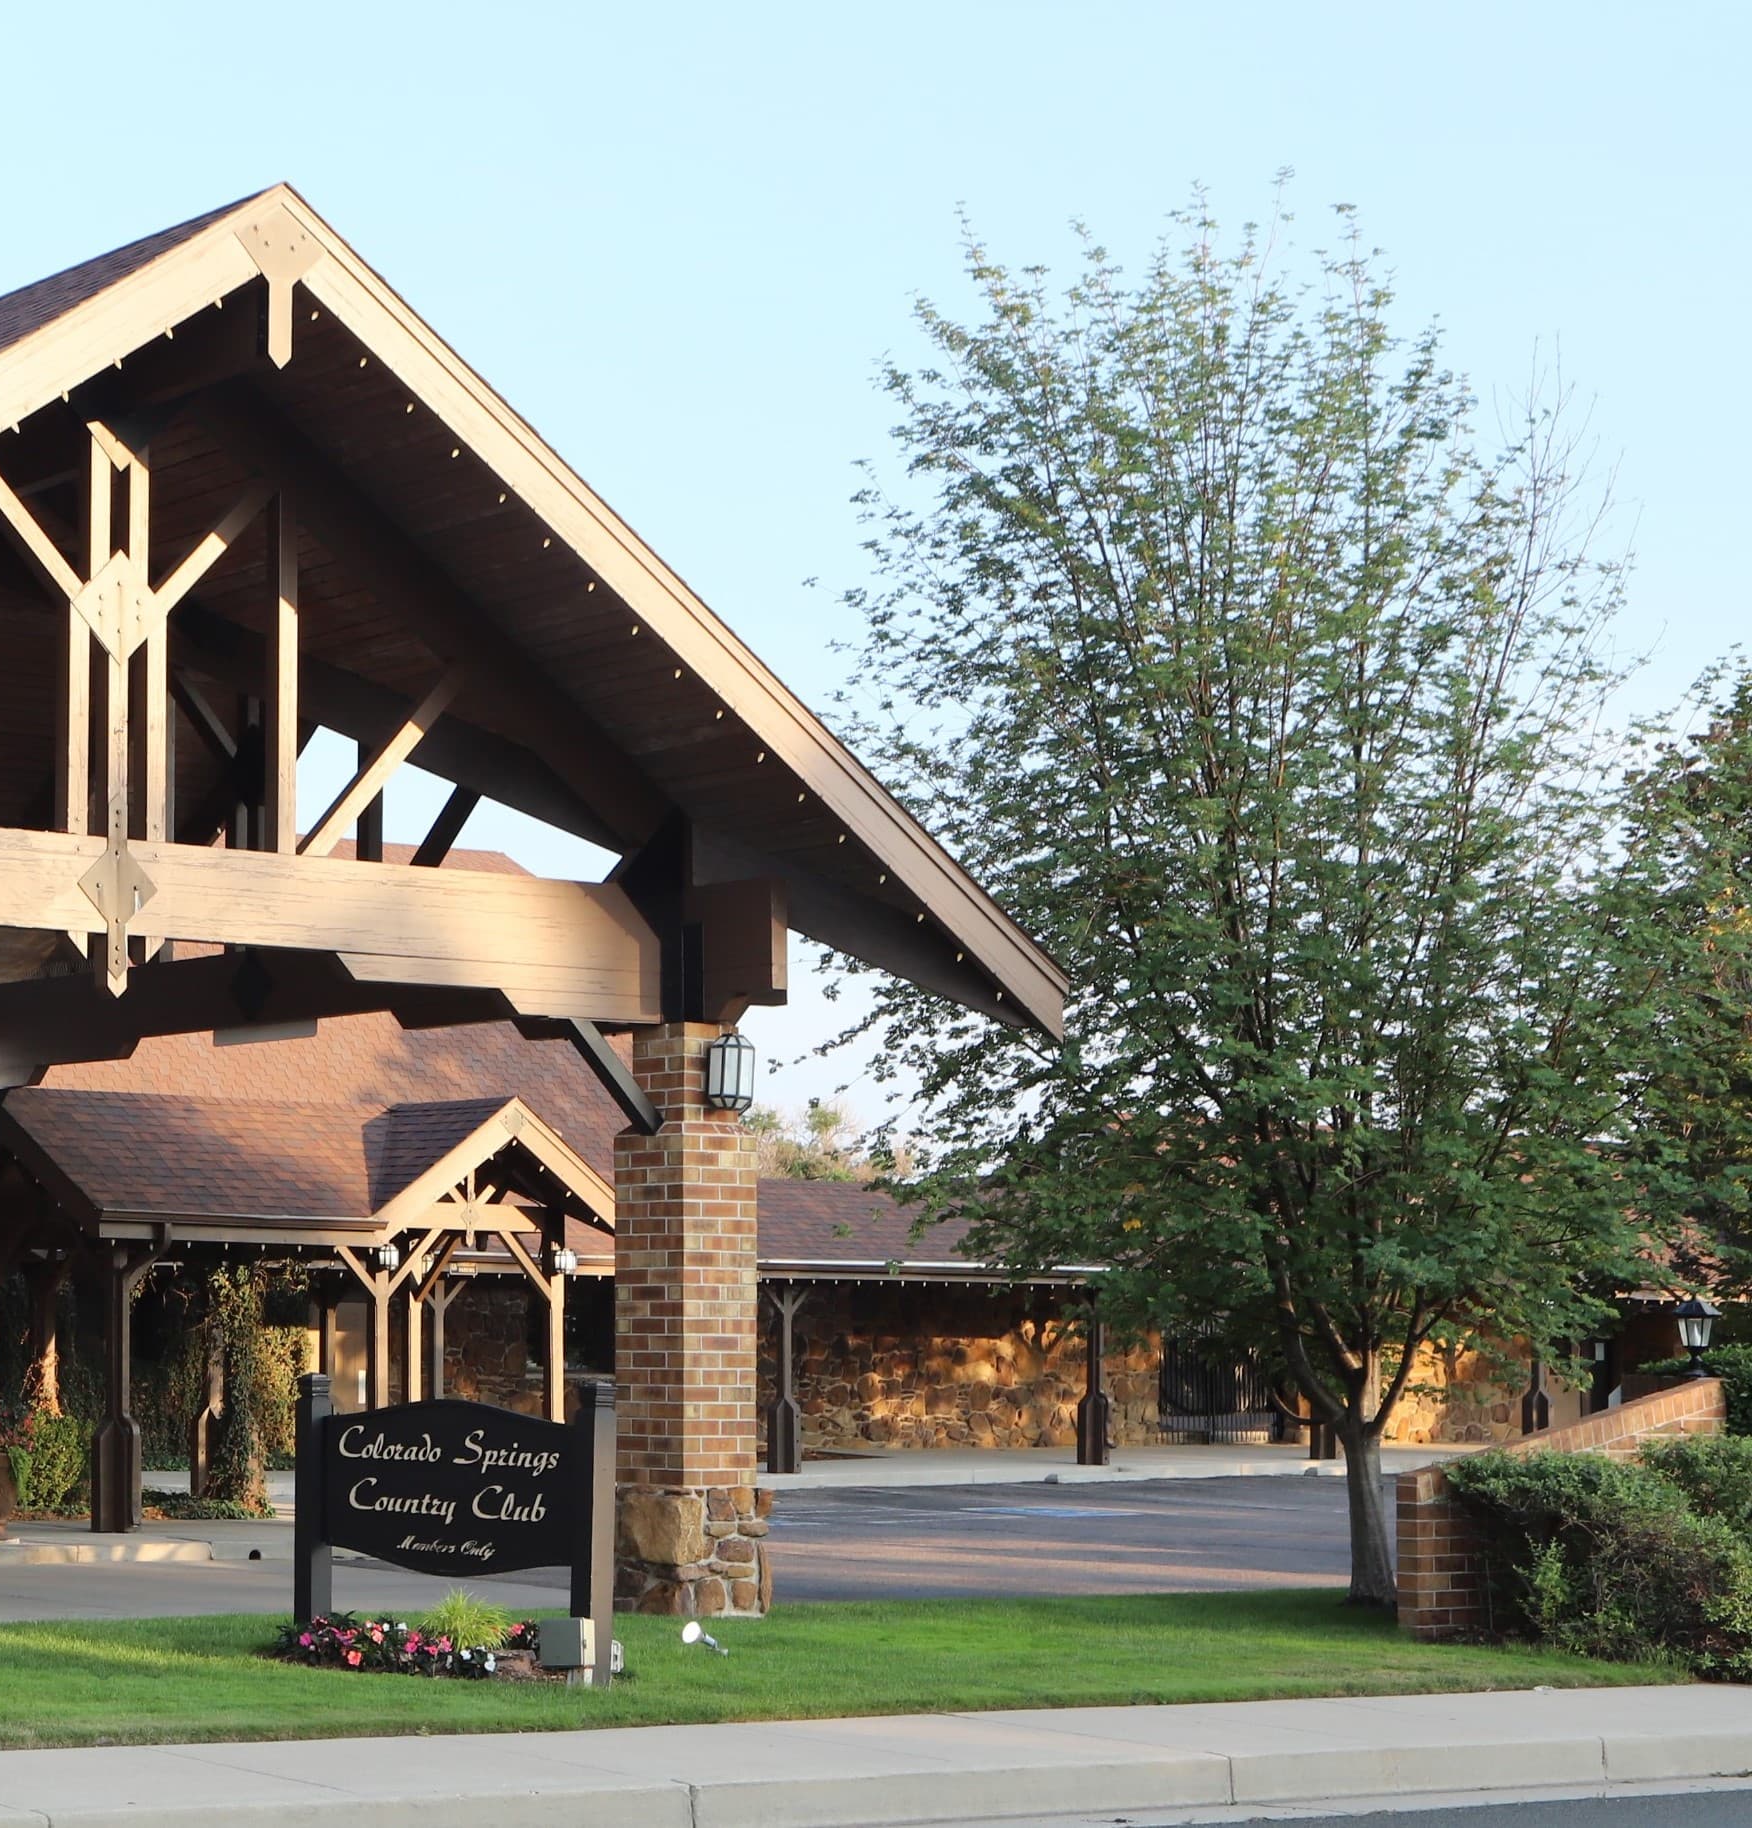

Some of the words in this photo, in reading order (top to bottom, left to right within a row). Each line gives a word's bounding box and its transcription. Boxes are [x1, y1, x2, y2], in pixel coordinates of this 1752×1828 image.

[339, 1425, 442, 1462] Colorado
[453, 1430, 560, 1476] Springs
[349, 1478, 457, 1524] Country
[472, 1485, 546, 1522] Club
[396, 1535, 456, 1553] Members
[460, 1540, 496, 1561] Only
